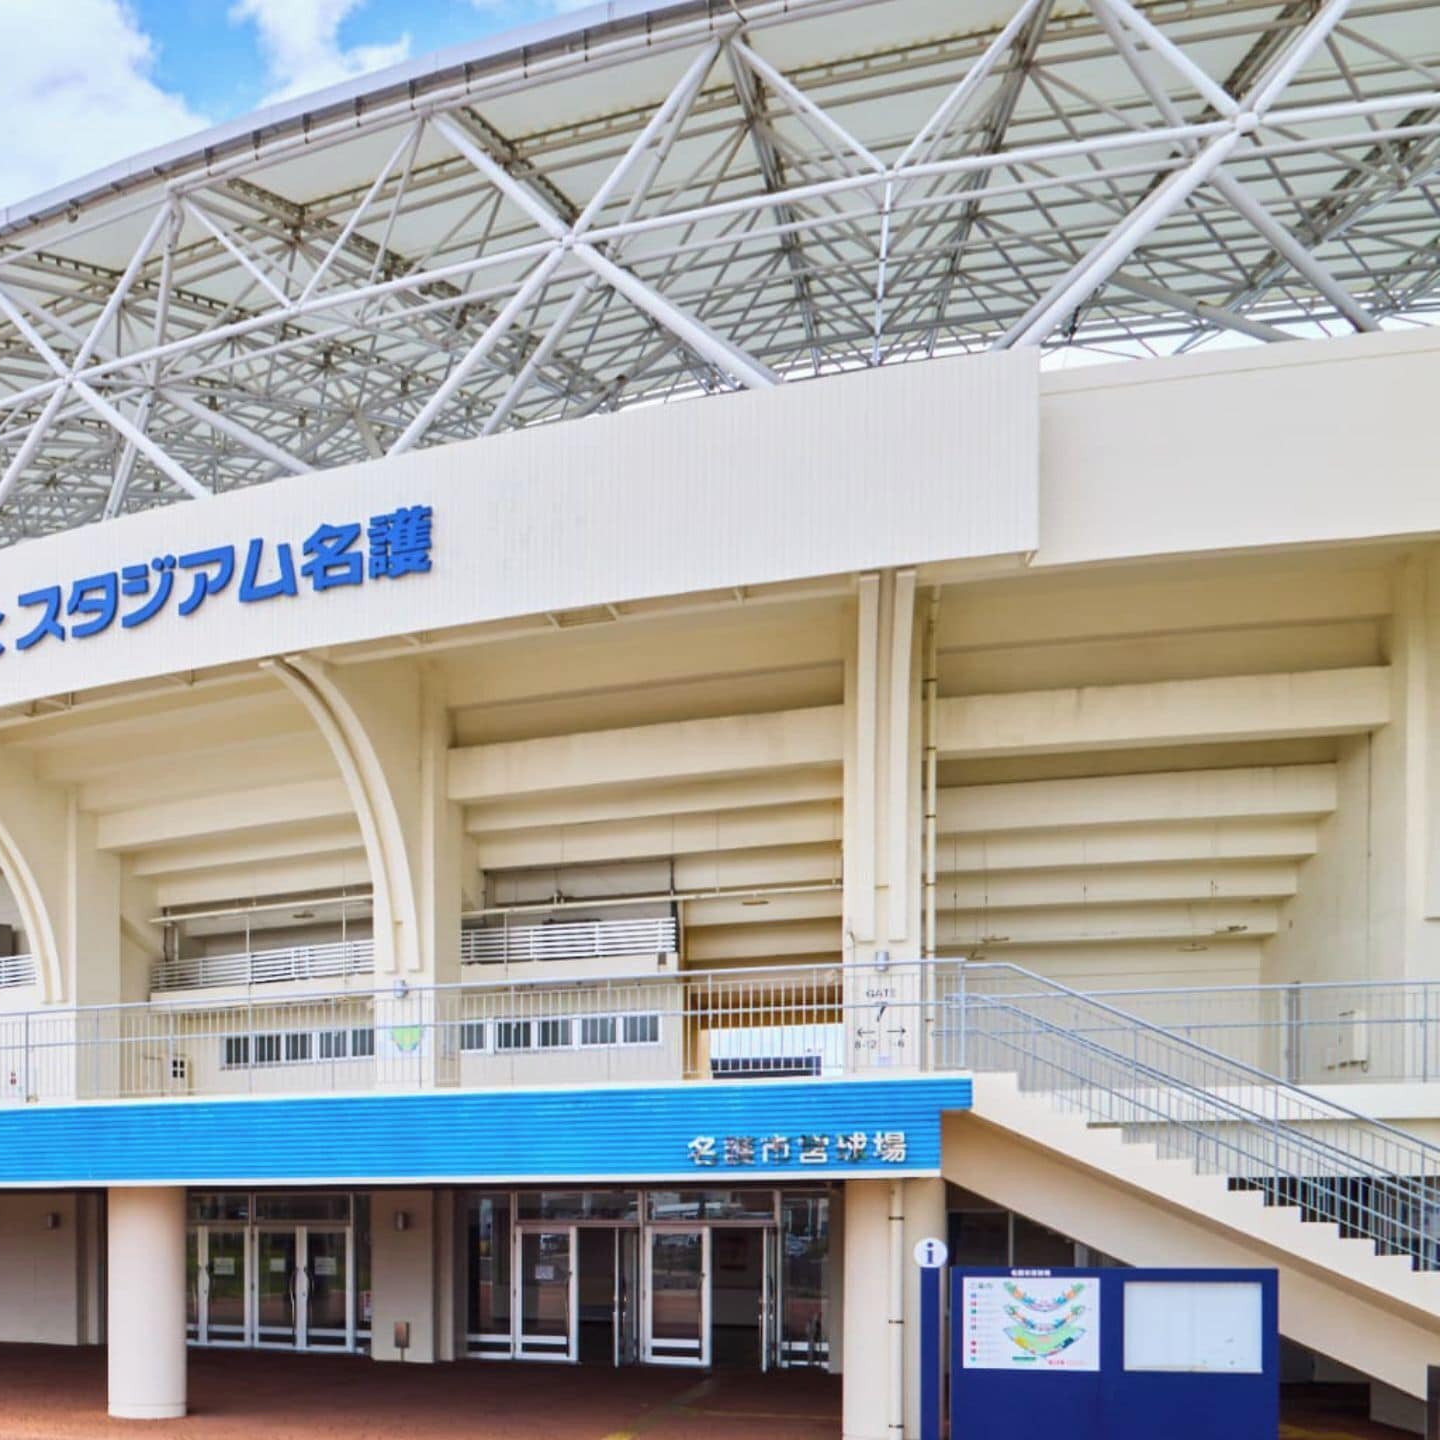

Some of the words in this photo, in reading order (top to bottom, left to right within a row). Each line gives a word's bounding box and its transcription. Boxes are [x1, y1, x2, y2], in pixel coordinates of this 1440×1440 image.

[16, 504, 433, 651] スタジアム名護
